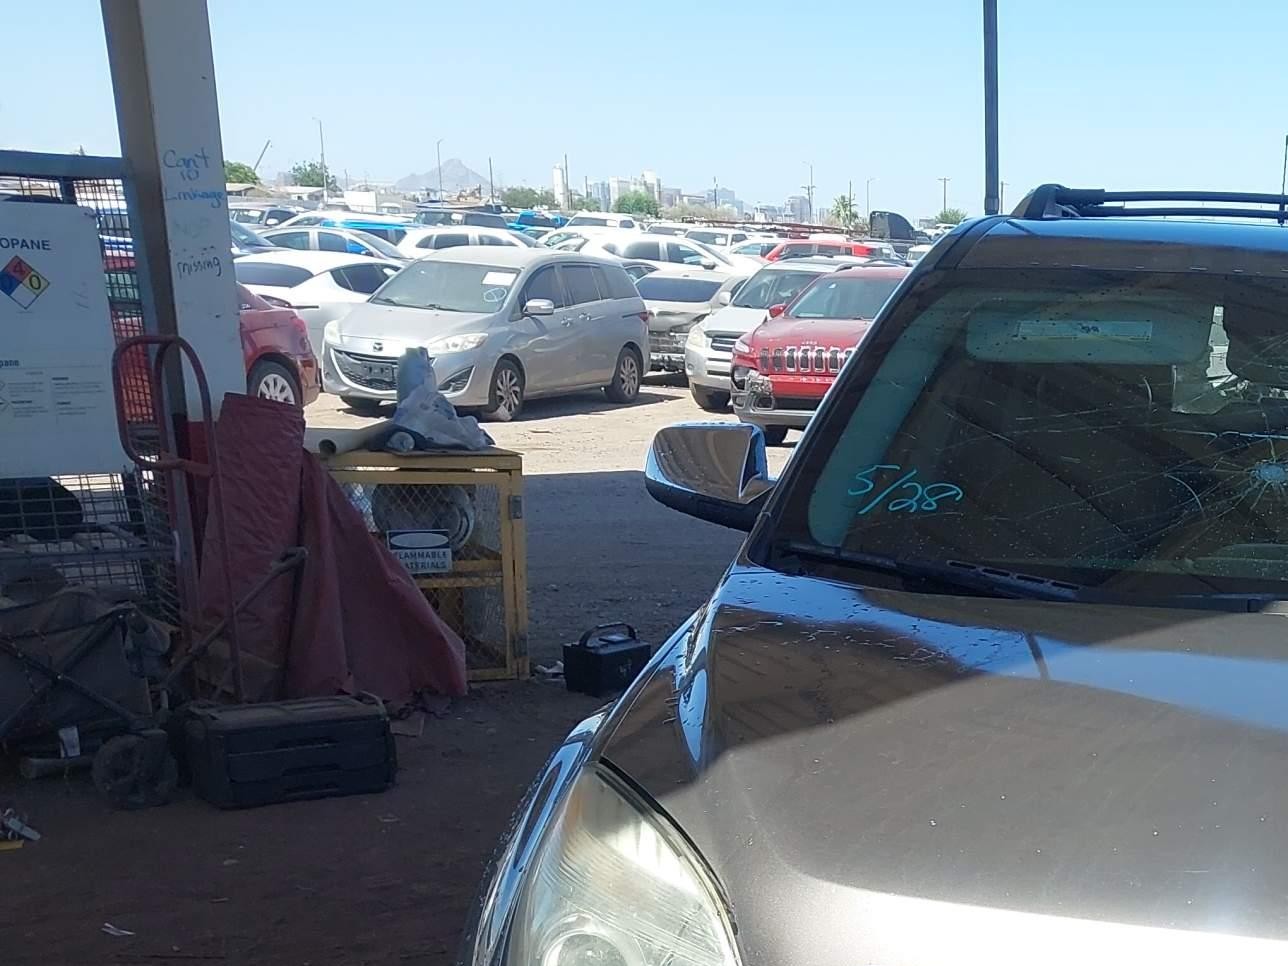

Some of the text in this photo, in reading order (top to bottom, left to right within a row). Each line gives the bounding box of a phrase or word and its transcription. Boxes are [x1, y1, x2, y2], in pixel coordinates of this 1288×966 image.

[29, 274, 42, 290] 0
[847, 464, 964, 514] 5/28
[398, 551, 448, 560] LAMMABLE
[404, 561, 447, 569] ATERIALS
